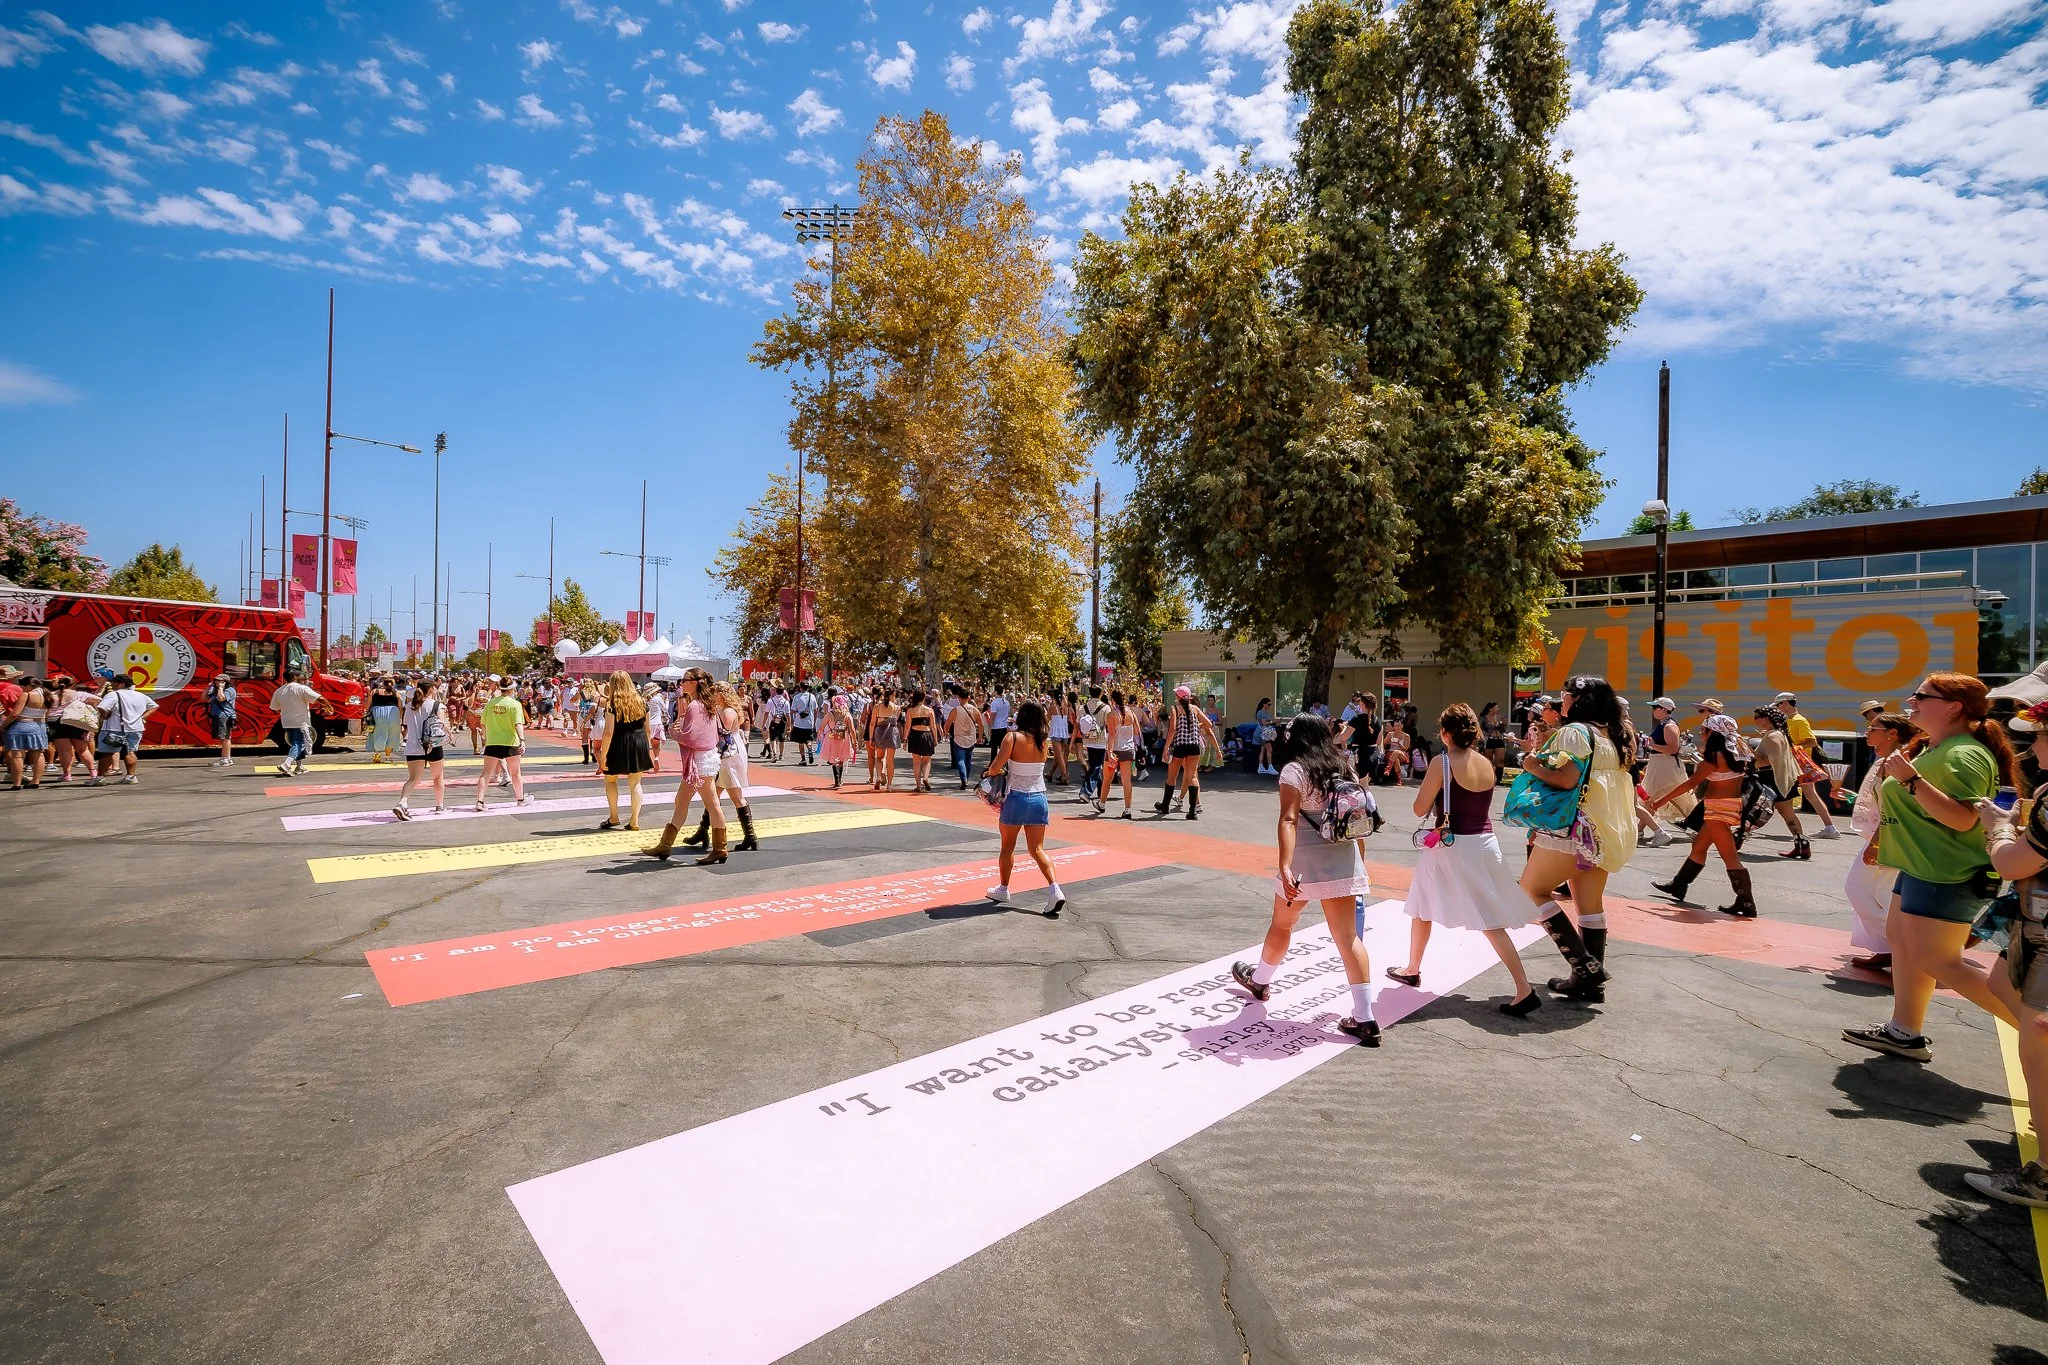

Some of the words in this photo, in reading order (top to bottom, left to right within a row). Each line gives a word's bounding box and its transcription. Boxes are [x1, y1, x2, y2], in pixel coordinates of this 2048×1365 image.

[106, 627, 136, 644] HOT
[154, 629, 191, 678] CHICKEN
[448, 944, 497, 955] am
[509, 935, 553, 947] no
[566, 916, 679, 937] longer
[692, 893, 833, 919] accepting
[836, 884, 877, 896] the
[884, 872, 957, 887] things
[523, 945, 540, 954] I
[556, 937, 601, 948] am
[614, 911, 762, 939] changing
[765, 901, 815, 914] the
[821, 886, 905, 905] things
[933, 871, 1000, 886] cannot
[820, 895, 895, 914] Angela
[895, 888, 949, 900] Davis
[819, 1092, 891, 1116] "I
[905, 1047, 1034, 1095] want
[1040, 1024, 1098, 1044] to
[1095, 1004, 1156, 1023] be
[992, 1021, 1193, 1101] catalyst
[1190, 994, 1254, 1022] for
[1177, 1019, 1276, 1062] Shirley
[1267, 983, 1351, 1021] Chisholm
[1245, 1039, 1274, 1051] The
[1269, 1024, 1303, 1039] Good
[1273, 1035, 1325, 1056] 1973,
